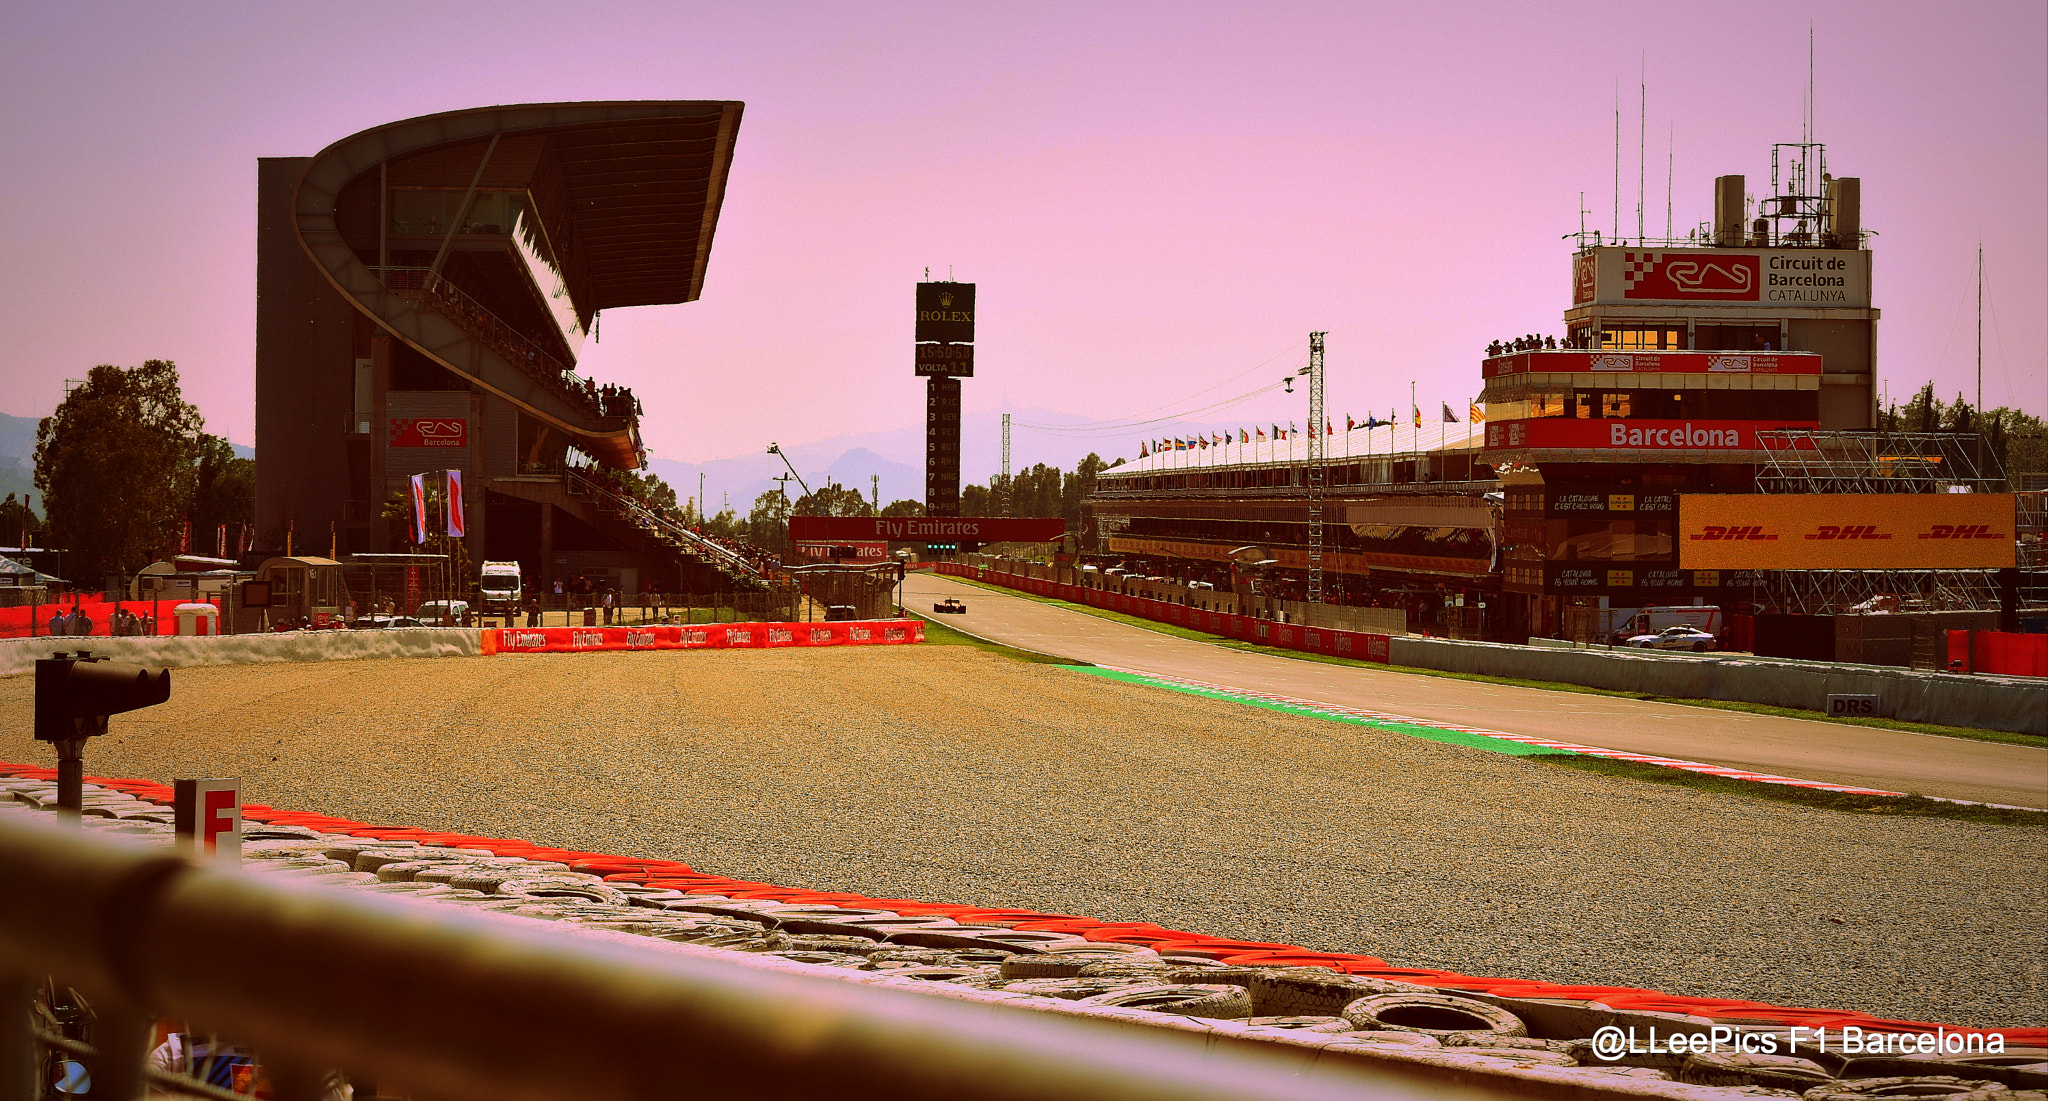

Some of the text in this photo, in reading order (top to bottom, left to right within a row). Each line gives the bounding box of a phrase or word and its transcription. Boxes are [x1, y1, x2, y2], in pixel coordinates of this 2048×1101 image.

[1769, 255, 1846, 270] Circuit de
[1768, 273, 1845, 287] Barcelona
[1768, 289, 1846, 302] CATALUNYA
[920, 311, 972, 322] ROLEX
[918, 361, 968, 374] VOLTA 11
[929, 383, 936, 392] 1
[929, 397, 936, 406] 2
[929, 412, 936, 421] 3
[928, 427, 936, 436] 4
[1610, 422, 1739, 447] Barcelona
[423, 438, 460, 446] Barcelona
[928, 442, 936, 451] 5
[928, 457, 936, 466] 6
[928, 472, 936, 481] 7
[928, 487, 936, 496] 8
[928, 502, 936, 511] 9
[875, 519, 979, 538] Fly Emirates
[1701, 526, 1769, 540] DHL
[1815, 525, 1883, 539] DHL
[1929, 525, 1997, 539] DHL
[503, 630, 546, 650] Fly Emirates
[572, 630, 582, 649] Fly
[1833, 699, 1873, 713] DRS
[204, 789, 236, 859] F
